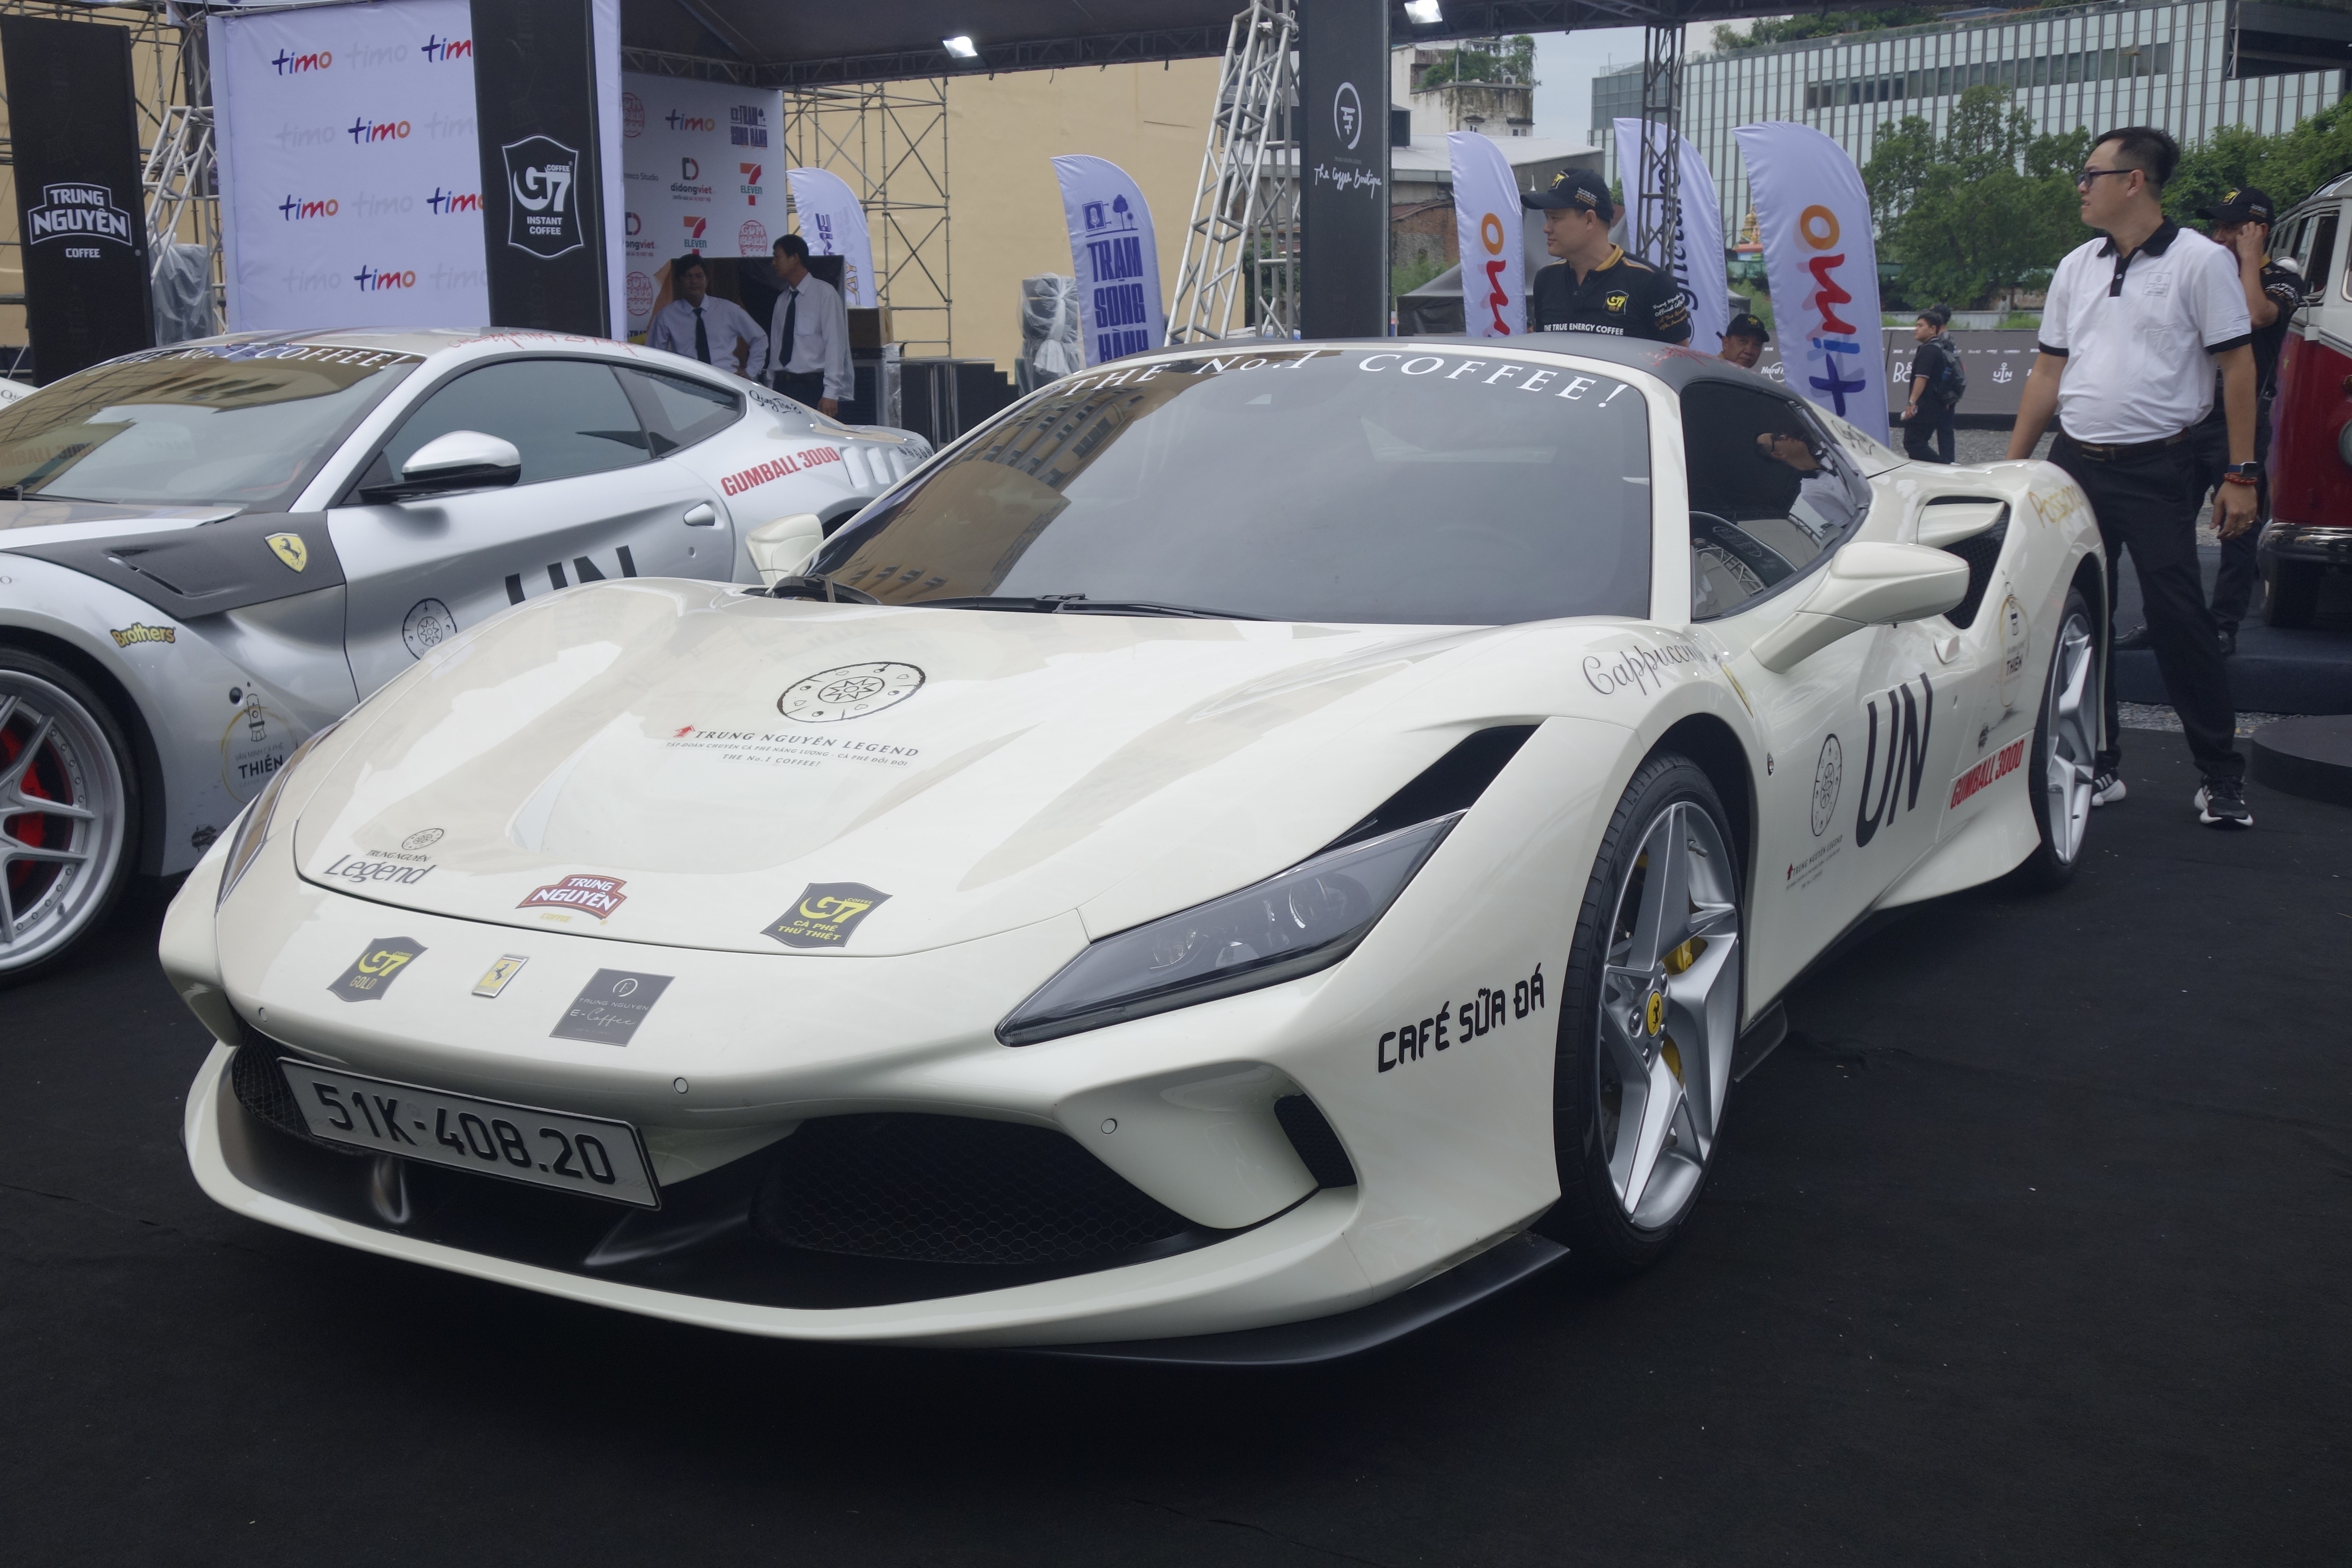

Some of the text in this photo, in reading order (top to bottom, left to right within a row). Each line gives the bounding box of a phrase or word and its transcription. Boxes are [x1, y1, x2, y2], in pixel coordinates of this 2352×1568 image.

[421, 34, 472, 63] tim
[272, 49, 332, 75] timo
[348, 117, 410, 144] timo
[665, 109, 715, 131] timo
[1314, 163, 1329, 186] The
[49, 189, 104, 207] TRUNG
[513, 166, 571, 211] G7
[671, 182, 712, 195] didongviet
[279, 194, 338, 221] timo
[34, 208, 127, 237] NGUYÊN
[527, 216, 562, 225] INSTANT
[529, 226, 561, 235] COFFEE
[741, 225, 764, 235] GUM
[65, 248, 100, 258] COFFEE
[354, 265, 416, 292] timo
[1093, 283, 1146, 328] SONG
[1607, 296, 1626, 307] G7
[1799, 205, 1866, 417] timo
[1569, 323, 1596, 331] ENERGY
[1596, 325, 1624, 335] COFFEE
[254, 347, 411, 370] COFFEE!
[1063, 363, 1171, 396] THE
[1192, 350, 1323, 375] No.1
[1359, 354, 1629, 408] COFFEE!
[721, 446, 840, 497] GUMBALL 3000
[110, 622, 175, 648] Brothers
[695, 731, 919, 757] TRUNG NGUYÊN LEGEND
[775, 758, 821, 767] COFFEE!
[1856, 671, 1933, 848] UN
[1950, 739, 2025, 810] GUMBALL 3000
[367, 849, 430, 862] TRUNG NGUYÊN
[1793, 859, 1808, 876] TRUNG
[1809, 846, 1826, 865] NGUYÊN
[1827, 834, 1843, 852] LEGEND
[324, 854, 437, 885] Legend
[569, 878, 616, 892] TRUNG
[532, 891, 617, 911] NGUYÊN
[799, 896, 870, 923] G7
[847, 897, 874, 905] COFFEE
[540, 913, 573, 923] COFFEE
[793, 919, 837, 933] CÀ PHÊ
[777, 924, 842, 942] THỨ THIỆT
[358, 950, 411, 978] G7
[395, 951, 413, 959] COFFEE
[349, 975, 376, 991] GOLD
[579, 998, 649, 1011] TRUNG NGUYEN
[1378, 962, 1545, 1073] CAFÉ SỮA ĐÁ
[312, 1082, 616, 1185] 51K-408.20
